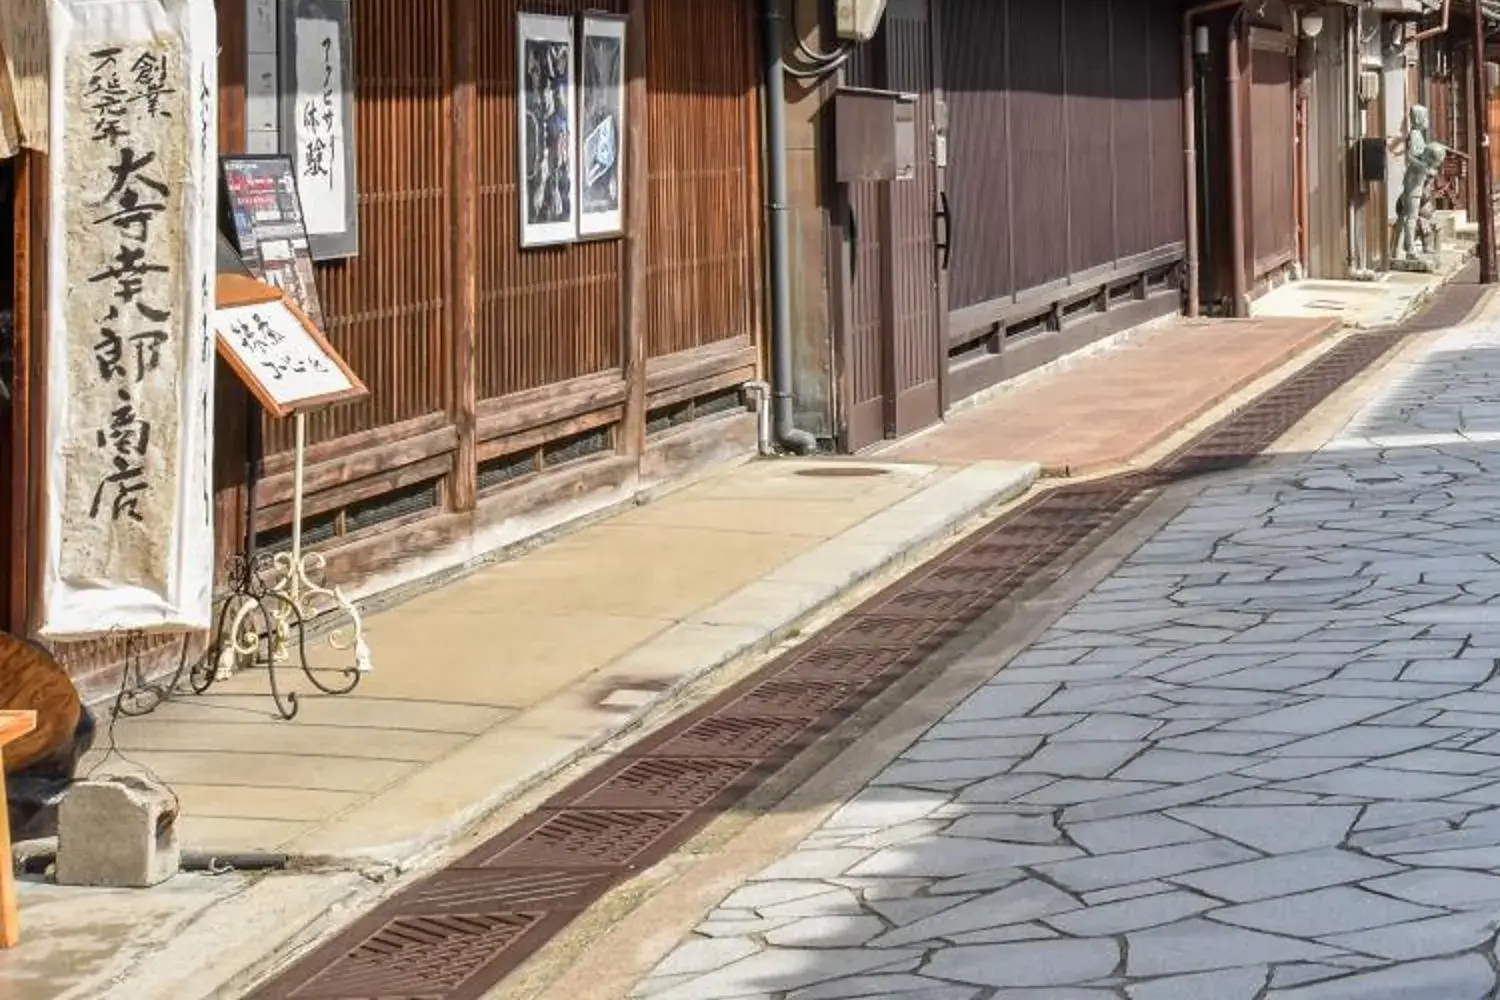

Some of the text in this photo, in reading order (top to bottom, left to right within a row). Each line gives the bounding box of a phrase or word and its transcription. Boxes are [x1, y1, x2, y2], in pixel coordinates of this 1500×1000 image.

[84, 47, 131, 148] 万延元年
[126, 51, 177, 119] 創業
[84, 148, 171, 522] 大寺幸八郎商店
